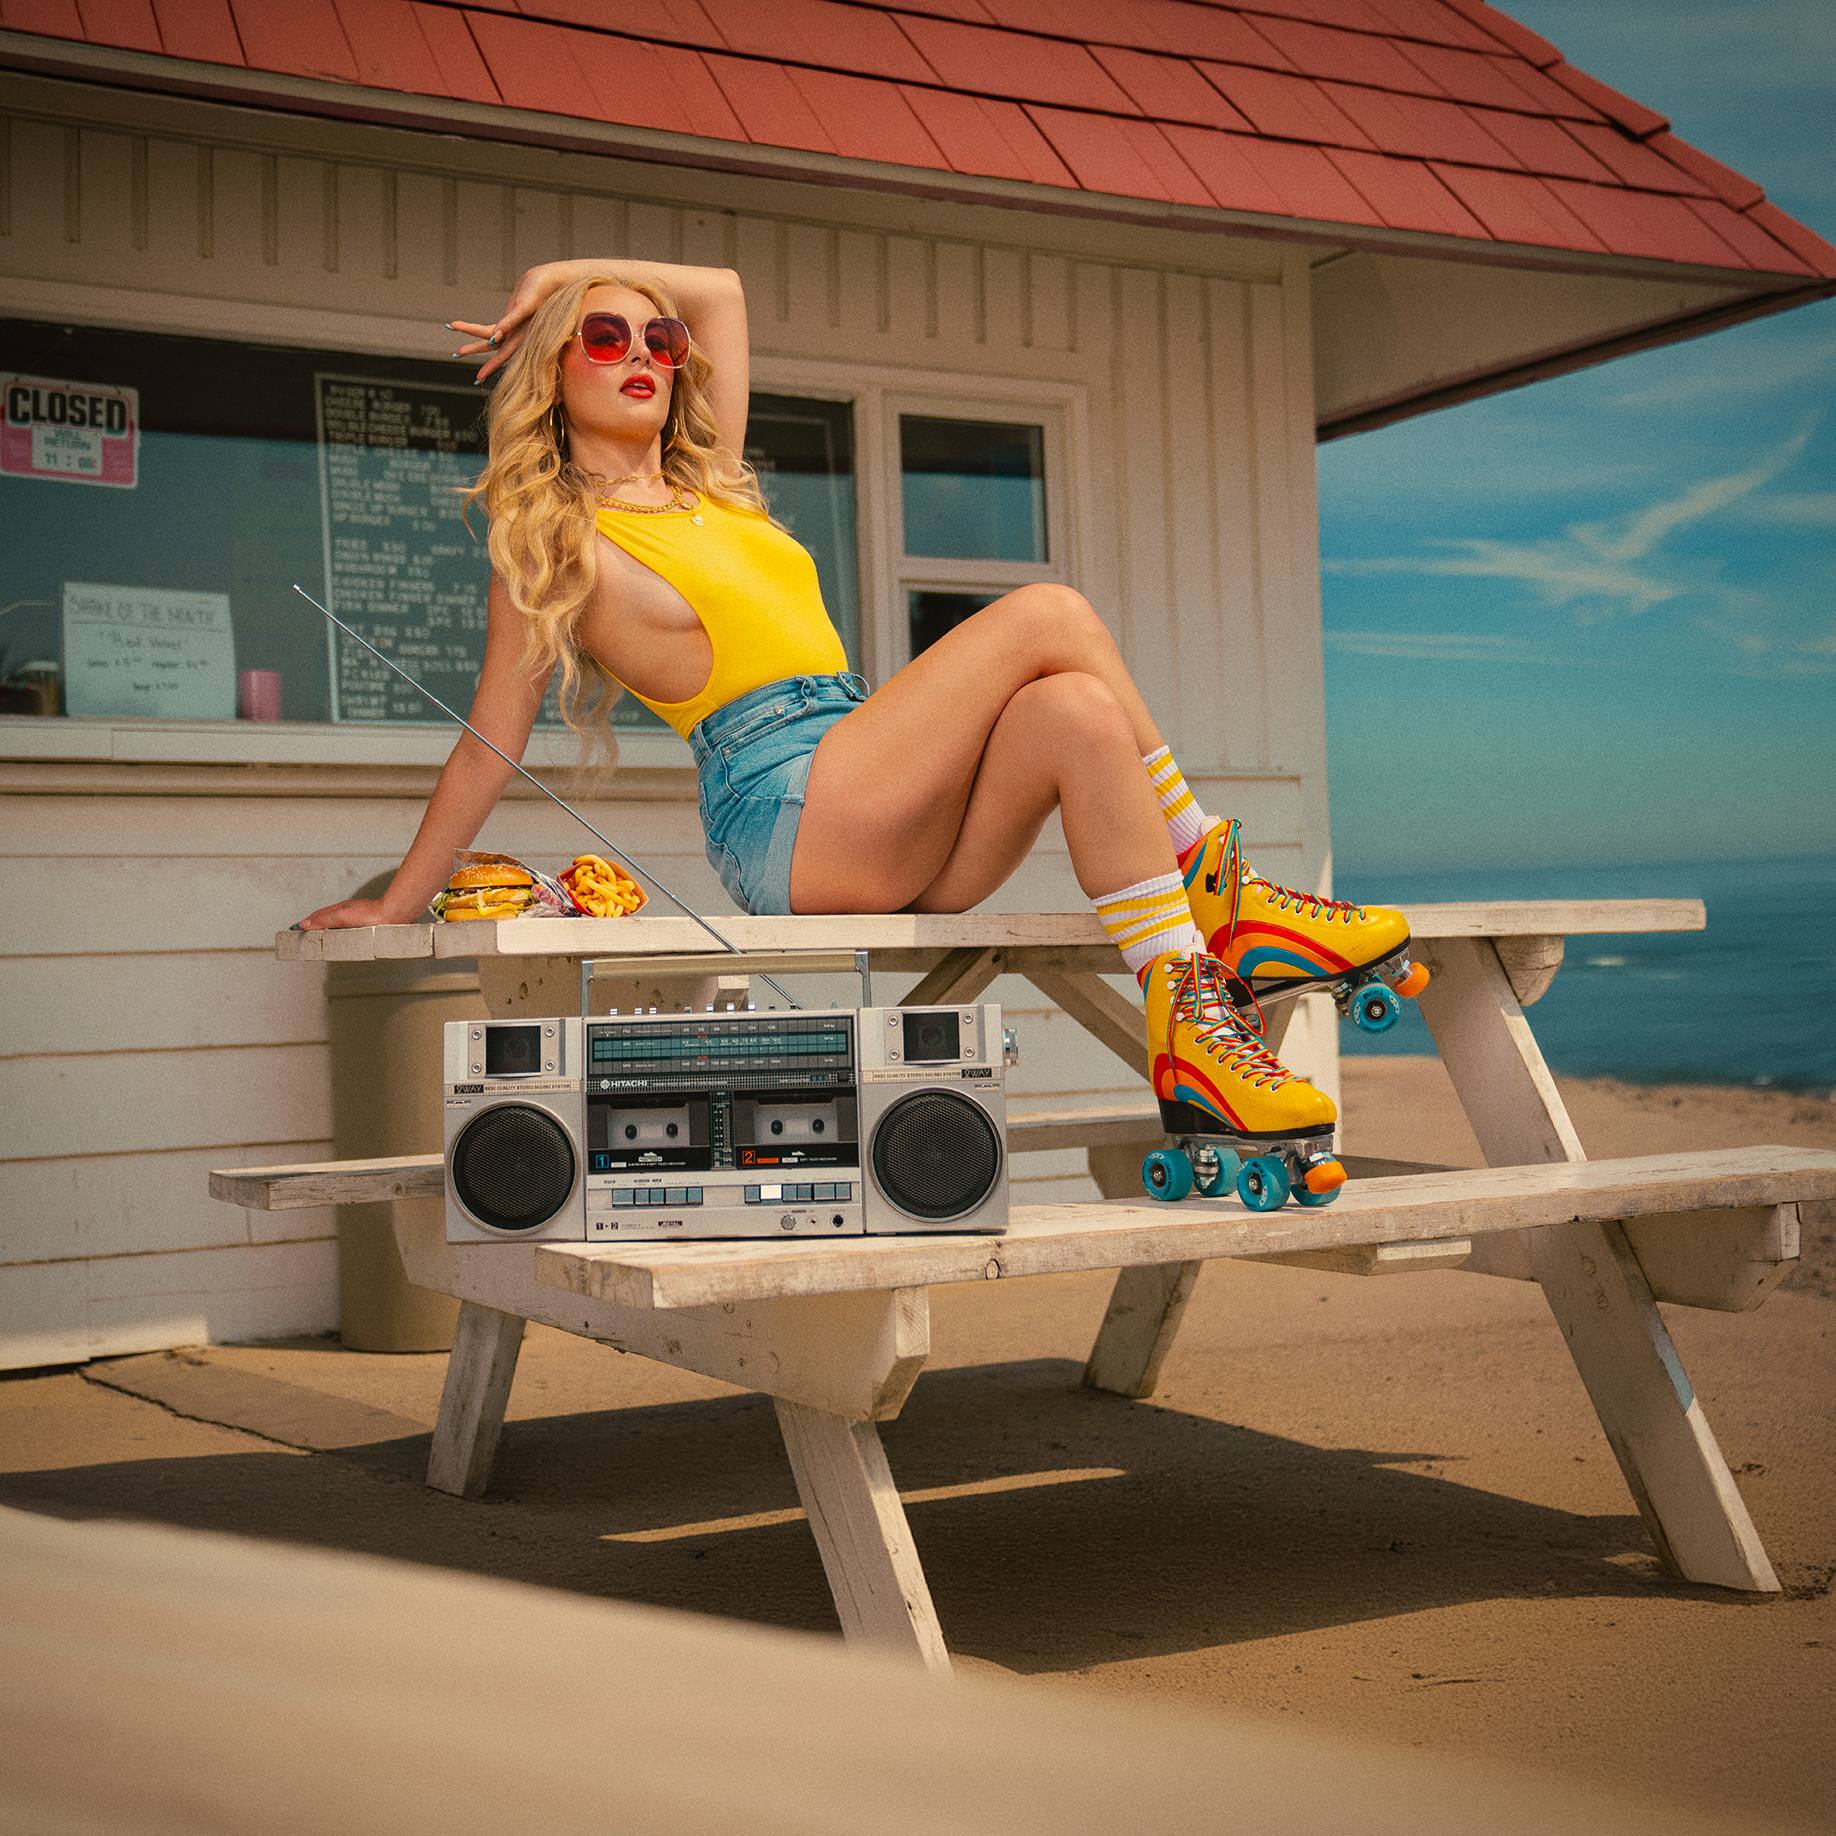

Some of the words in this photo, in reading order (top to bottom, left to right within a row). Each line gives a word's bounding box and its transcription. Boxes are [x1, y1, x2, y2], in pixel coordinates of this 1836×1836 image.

[9, 386, 127, 434] CLOSED
[44, 437, 91, 450] RETURN
[611, 1080, 648, 1088] HITACHI
